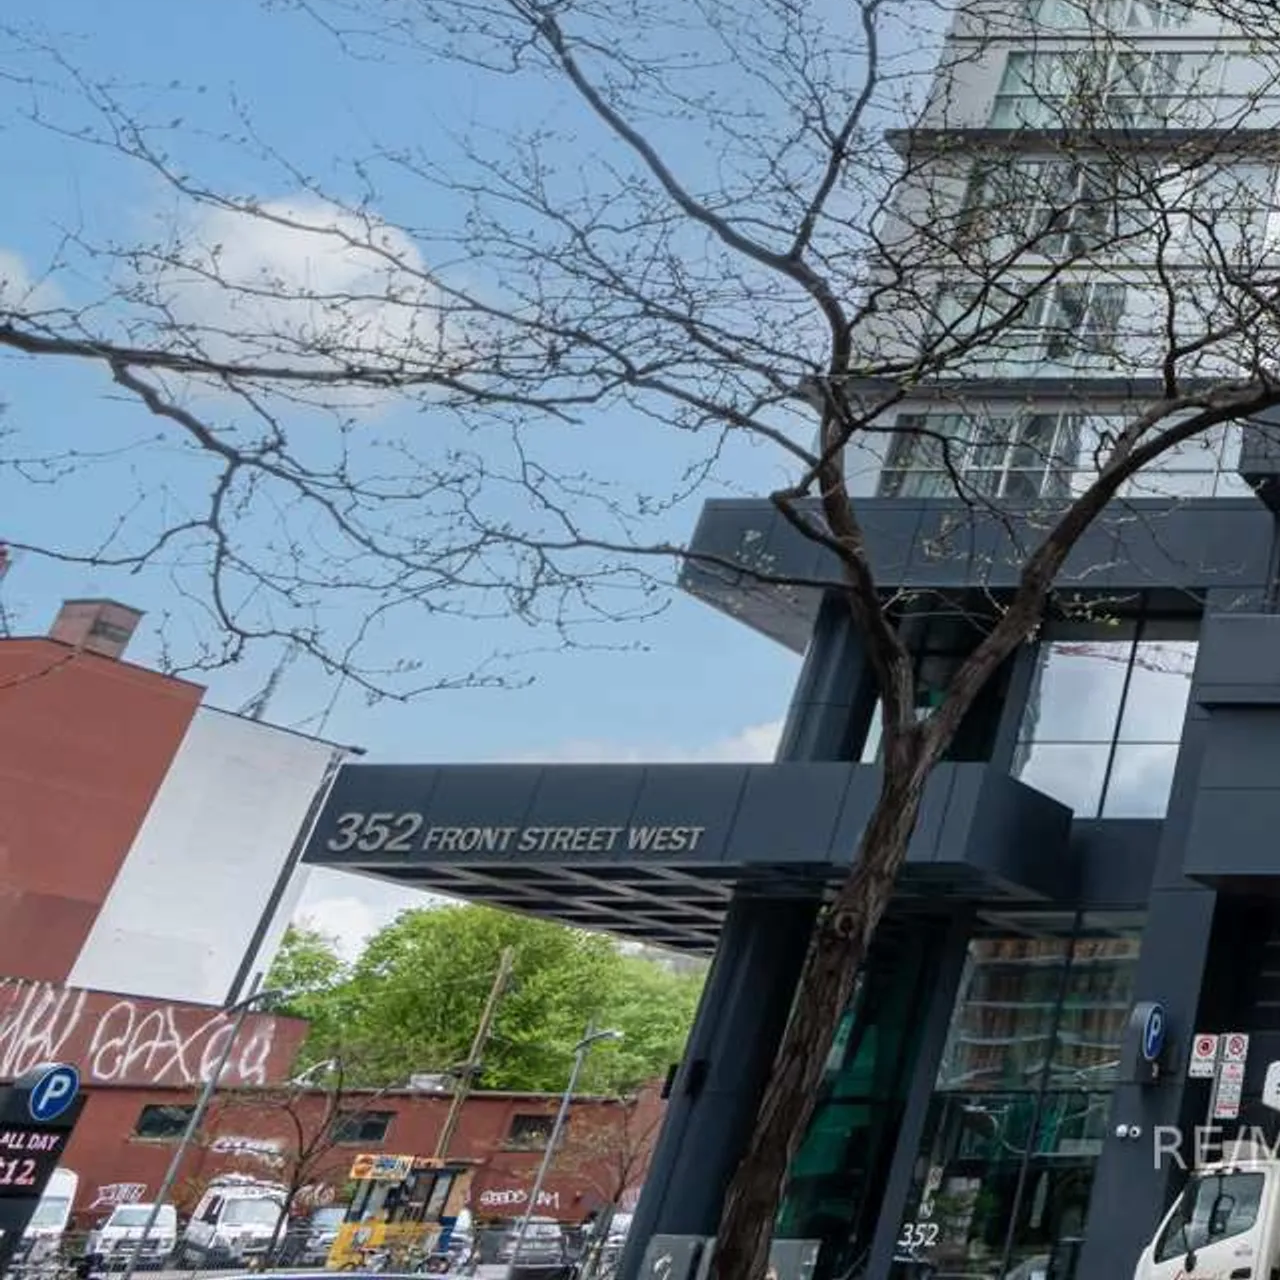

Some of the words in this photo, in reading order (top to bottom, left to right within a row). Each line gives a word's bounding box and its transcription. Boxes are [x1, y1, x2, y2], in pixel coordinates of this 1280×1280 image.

[328, 812, 422, 851] 352
[423, 826, 515, 850] FRONT
[518, 826, 623, 851] STREET
[627, 826, 704, 851] WEST
[27, 1133, 60, 1152] DAY
[897, 1222, 939, 1246] 352
